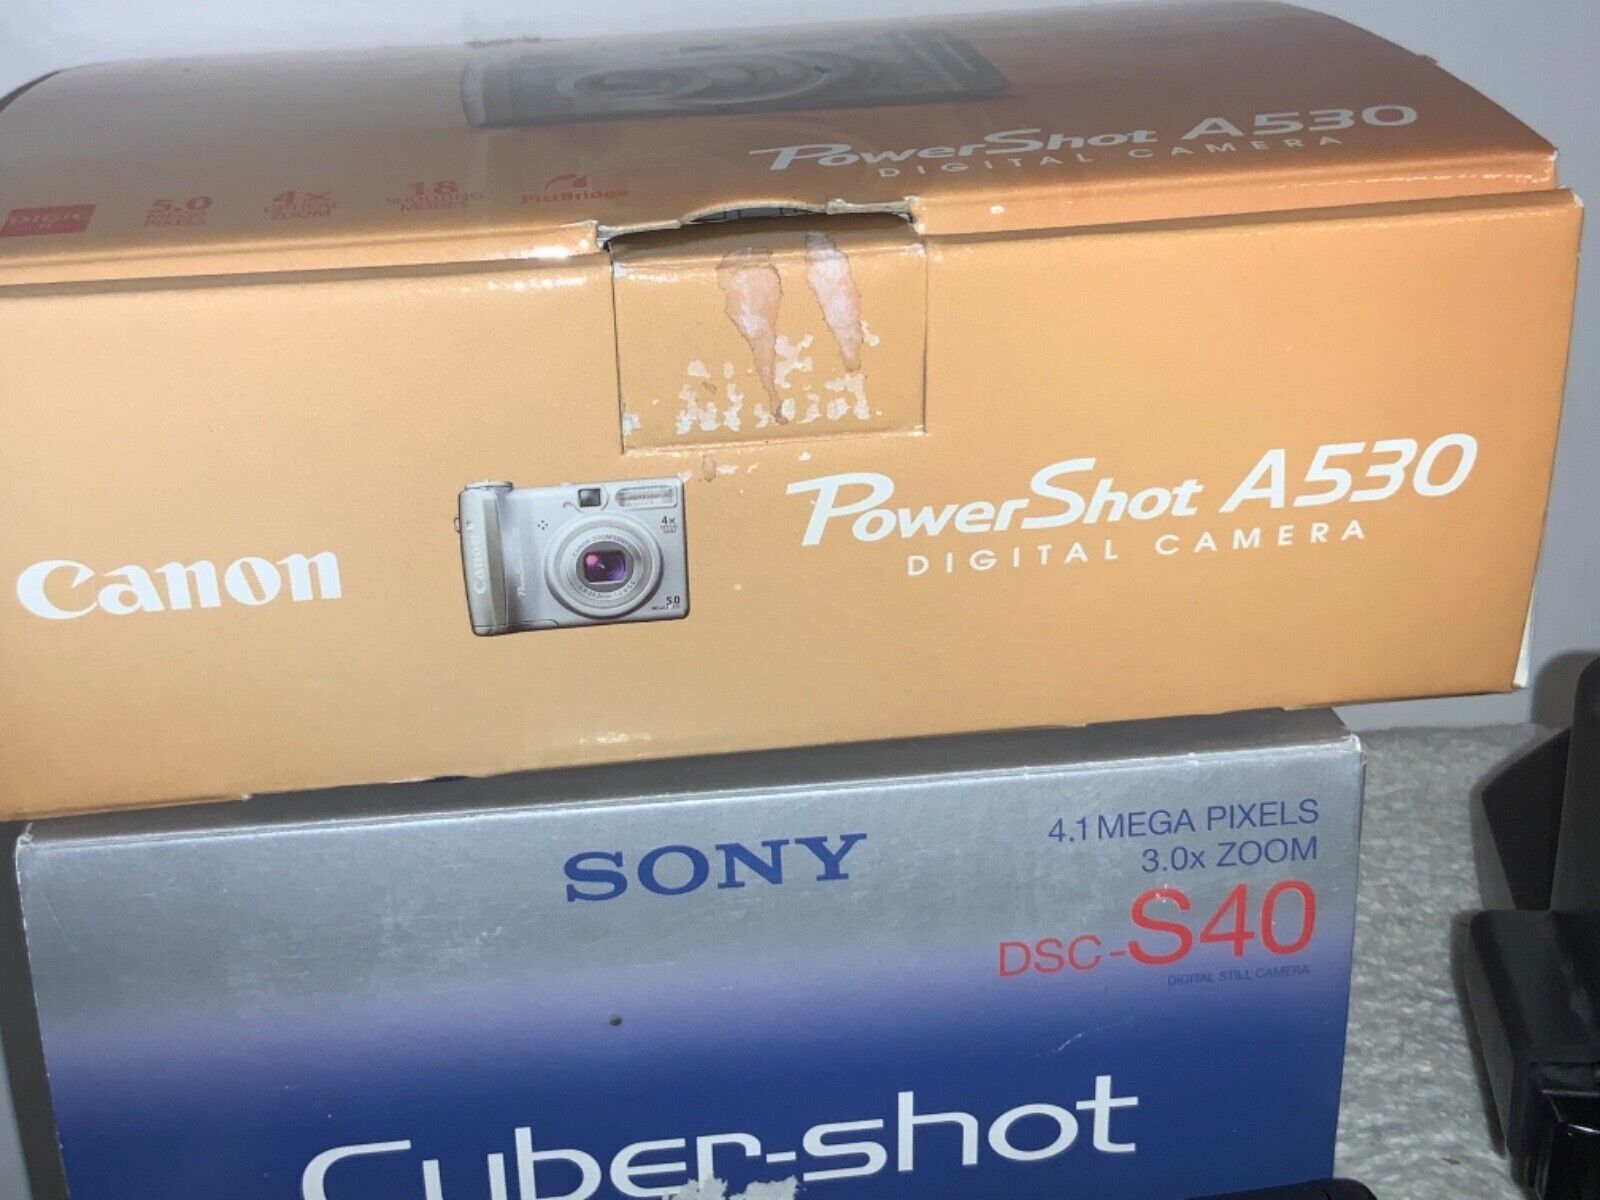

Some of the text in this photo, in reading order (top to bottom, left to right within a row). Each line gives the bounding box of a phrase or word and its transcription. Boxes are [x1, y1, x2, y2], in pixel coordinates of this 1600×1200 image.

[749, 104, 1418, 170] PowerShot A530
[877, 136, 1342, 178] DIGITAL CAMERA
[785, 433, 1478, 547] PowerShot A530
[906, 520, 1365, 576] DIGITAL CAMERA
[16, 551, 342, 620] Canon
[1048, 799, 1319, 843] 4.1 MEGA PIXELS
[563, 833, 867, 902] SONY
[1142, 836, 1318, 874] 3.0x ZOOM
[998, 879, 1317, 977] DSC-S40
[1167, 965, 1310, 986] DIGITAL STILL CAMERA
